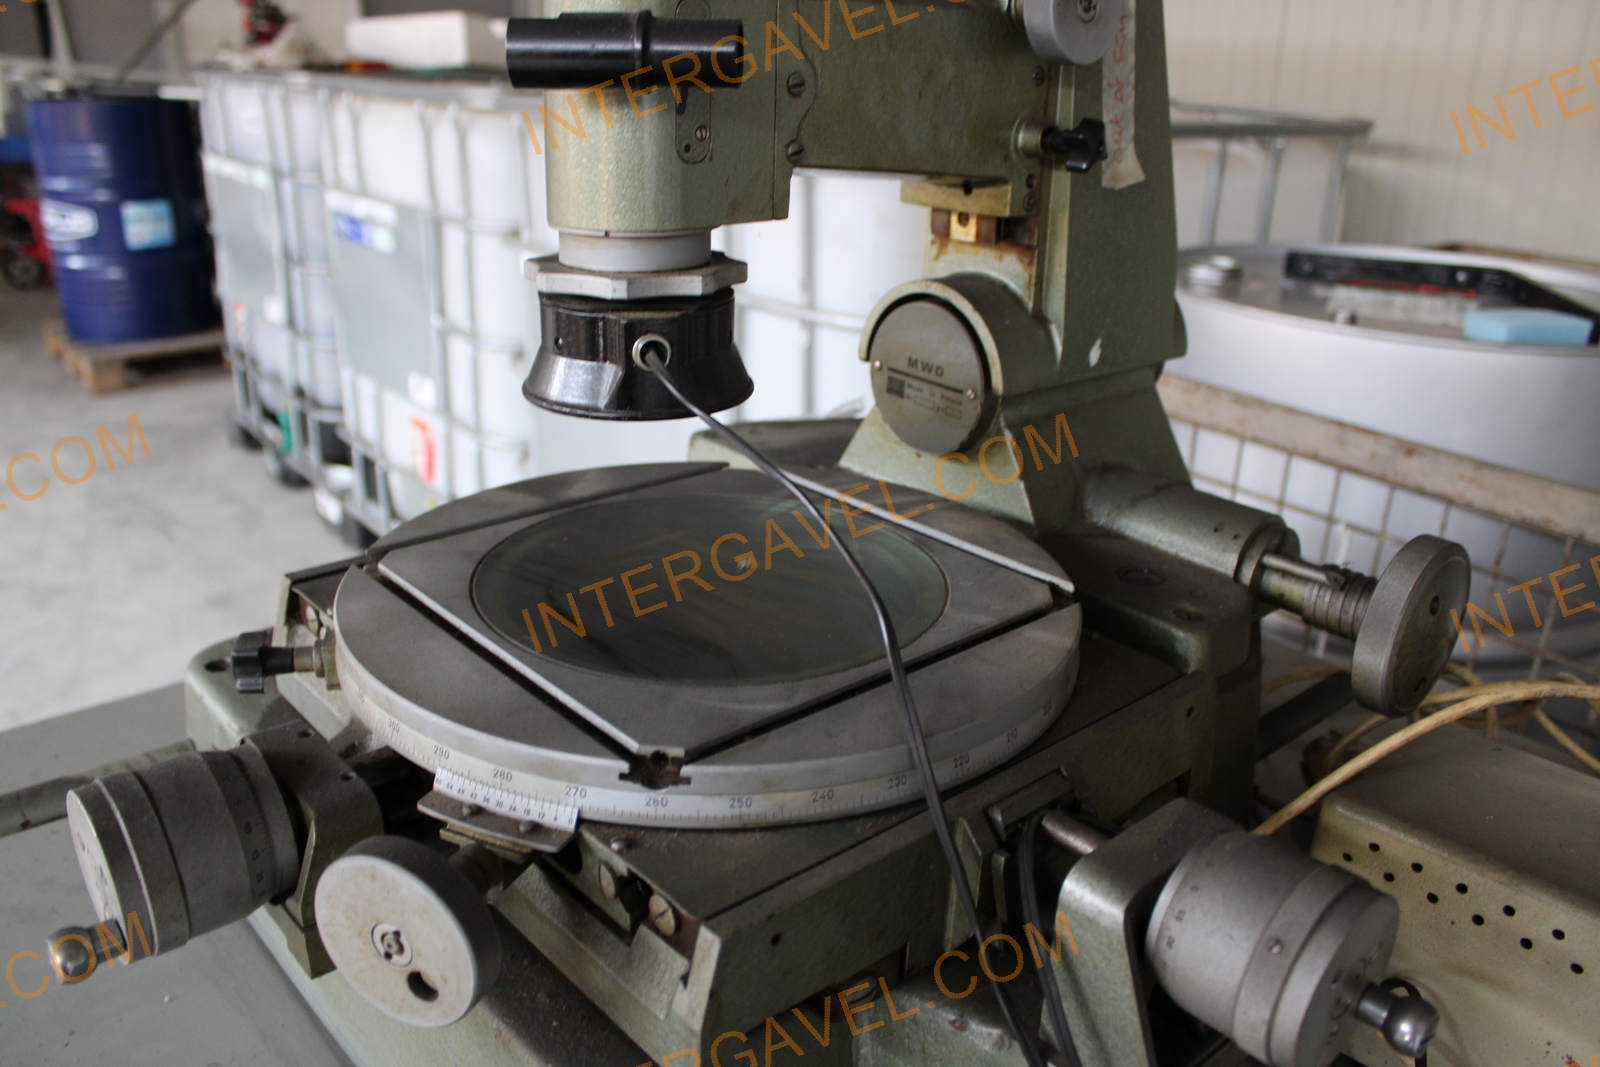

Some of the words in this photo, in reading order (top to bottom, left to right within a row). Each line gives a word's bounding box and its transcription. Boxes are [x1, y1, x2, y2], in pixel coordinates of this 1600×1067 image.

[907, 357, 943, 377] MWD
[434, 745, 450, 760] 290
[493, 767, 513, 783] 280
[565, 785, 587, 799] 270
[645, 795, 668, 808] 260
[729, 797, 752, 809] 250
[812, 789, 834, 803] 240
[887, 774, 907, 789] 230
[953, 753, 969, 769] 220
[538, 812, 545, 820] 12
